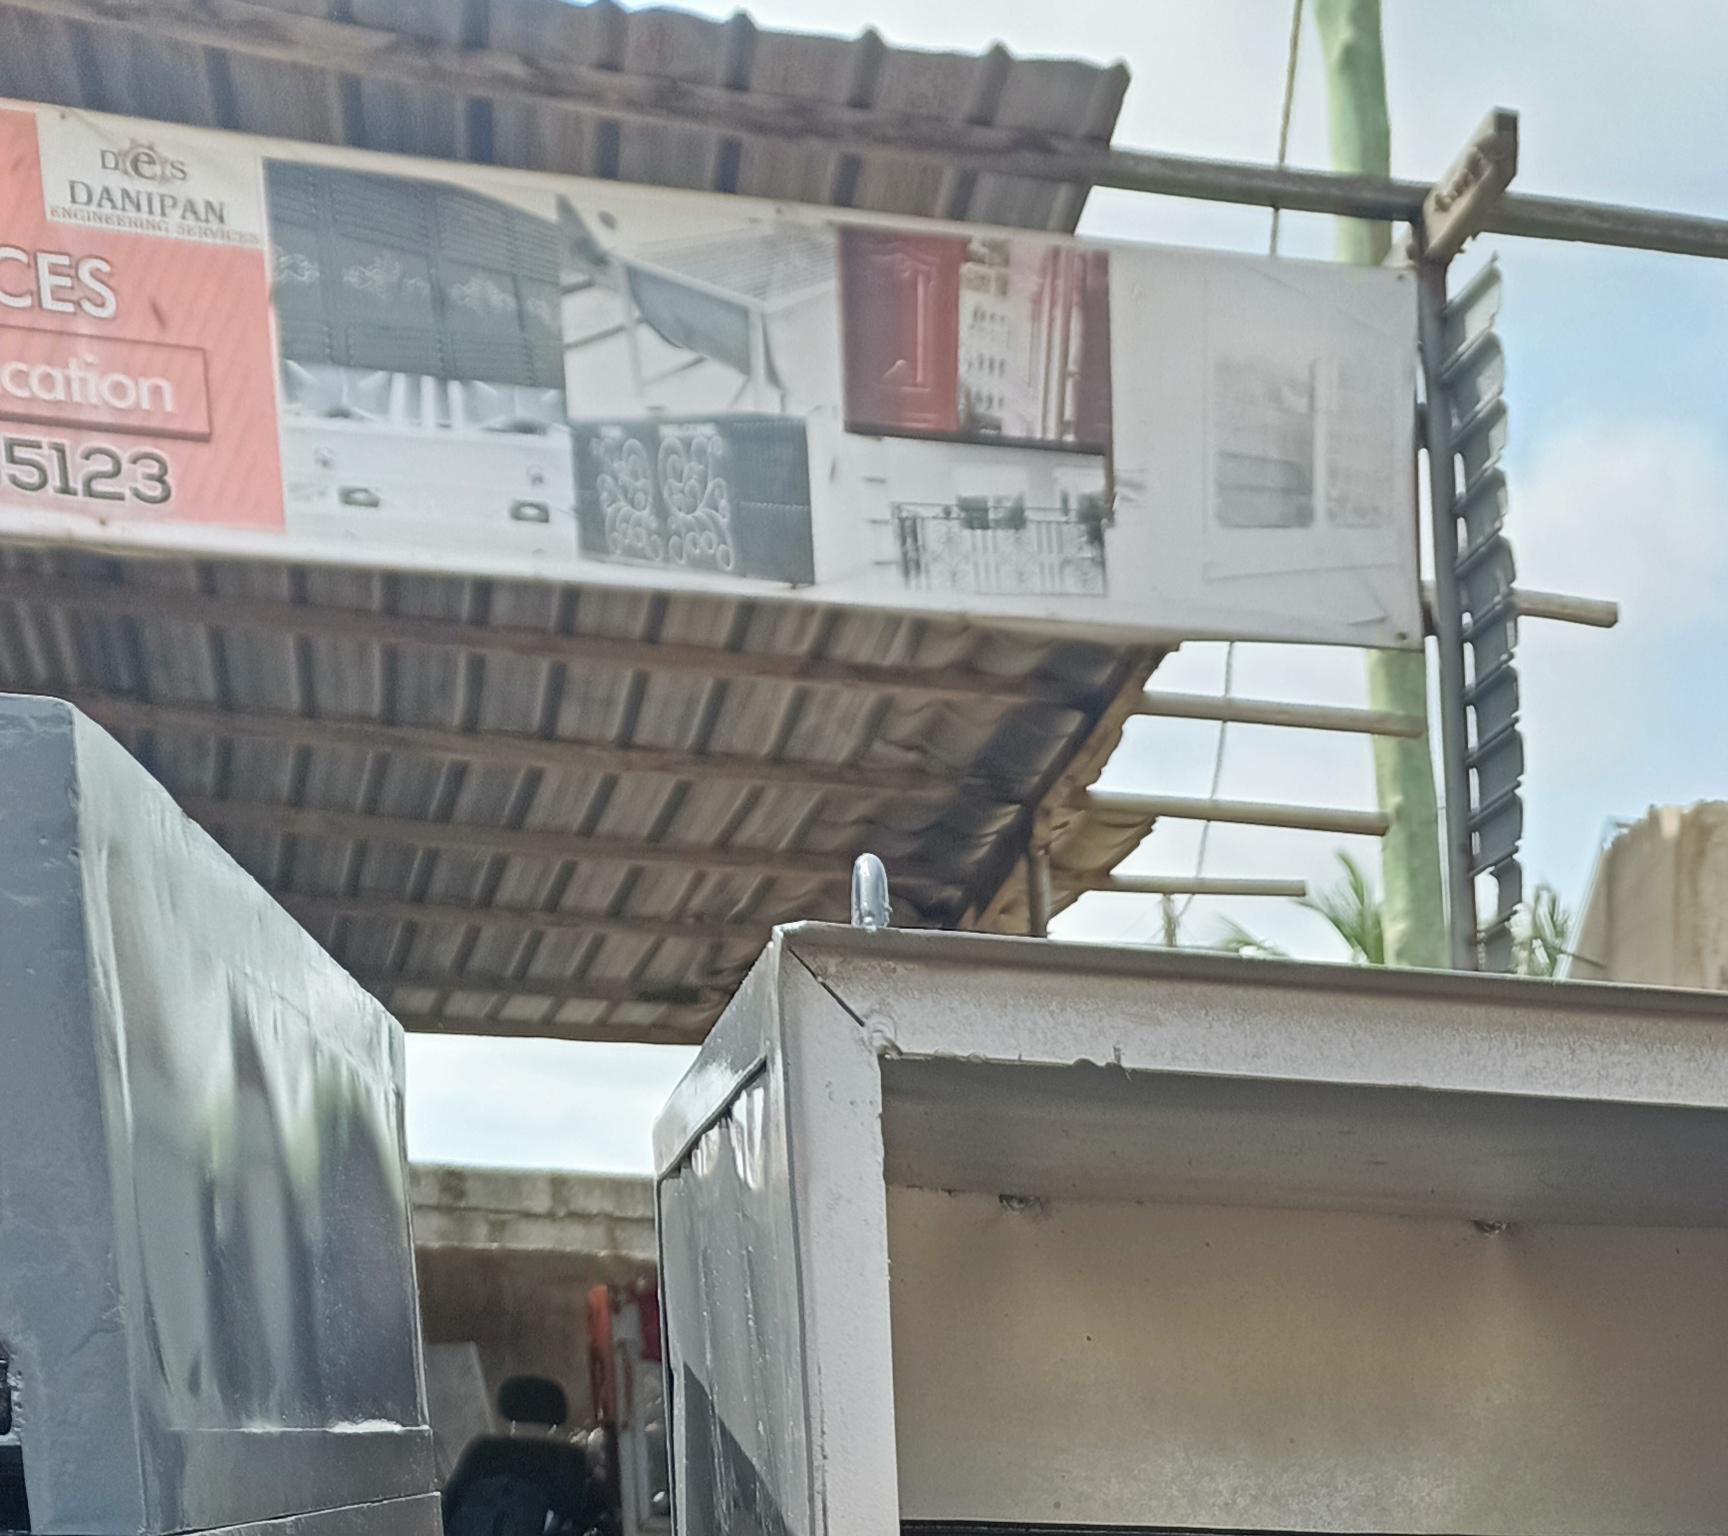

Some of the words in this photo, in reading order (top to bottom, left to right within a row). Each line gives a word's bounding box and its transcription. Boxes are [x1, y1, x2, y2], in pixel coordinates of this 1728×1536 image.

[50, 205, 169, 232] ENGINEERING
[176, 223, 259, 245] SERVICES
[67, 180, 225, 225] DANIPAN
[1, 353, 173, 413] cation
[3, 436, 172, 504] 5123
